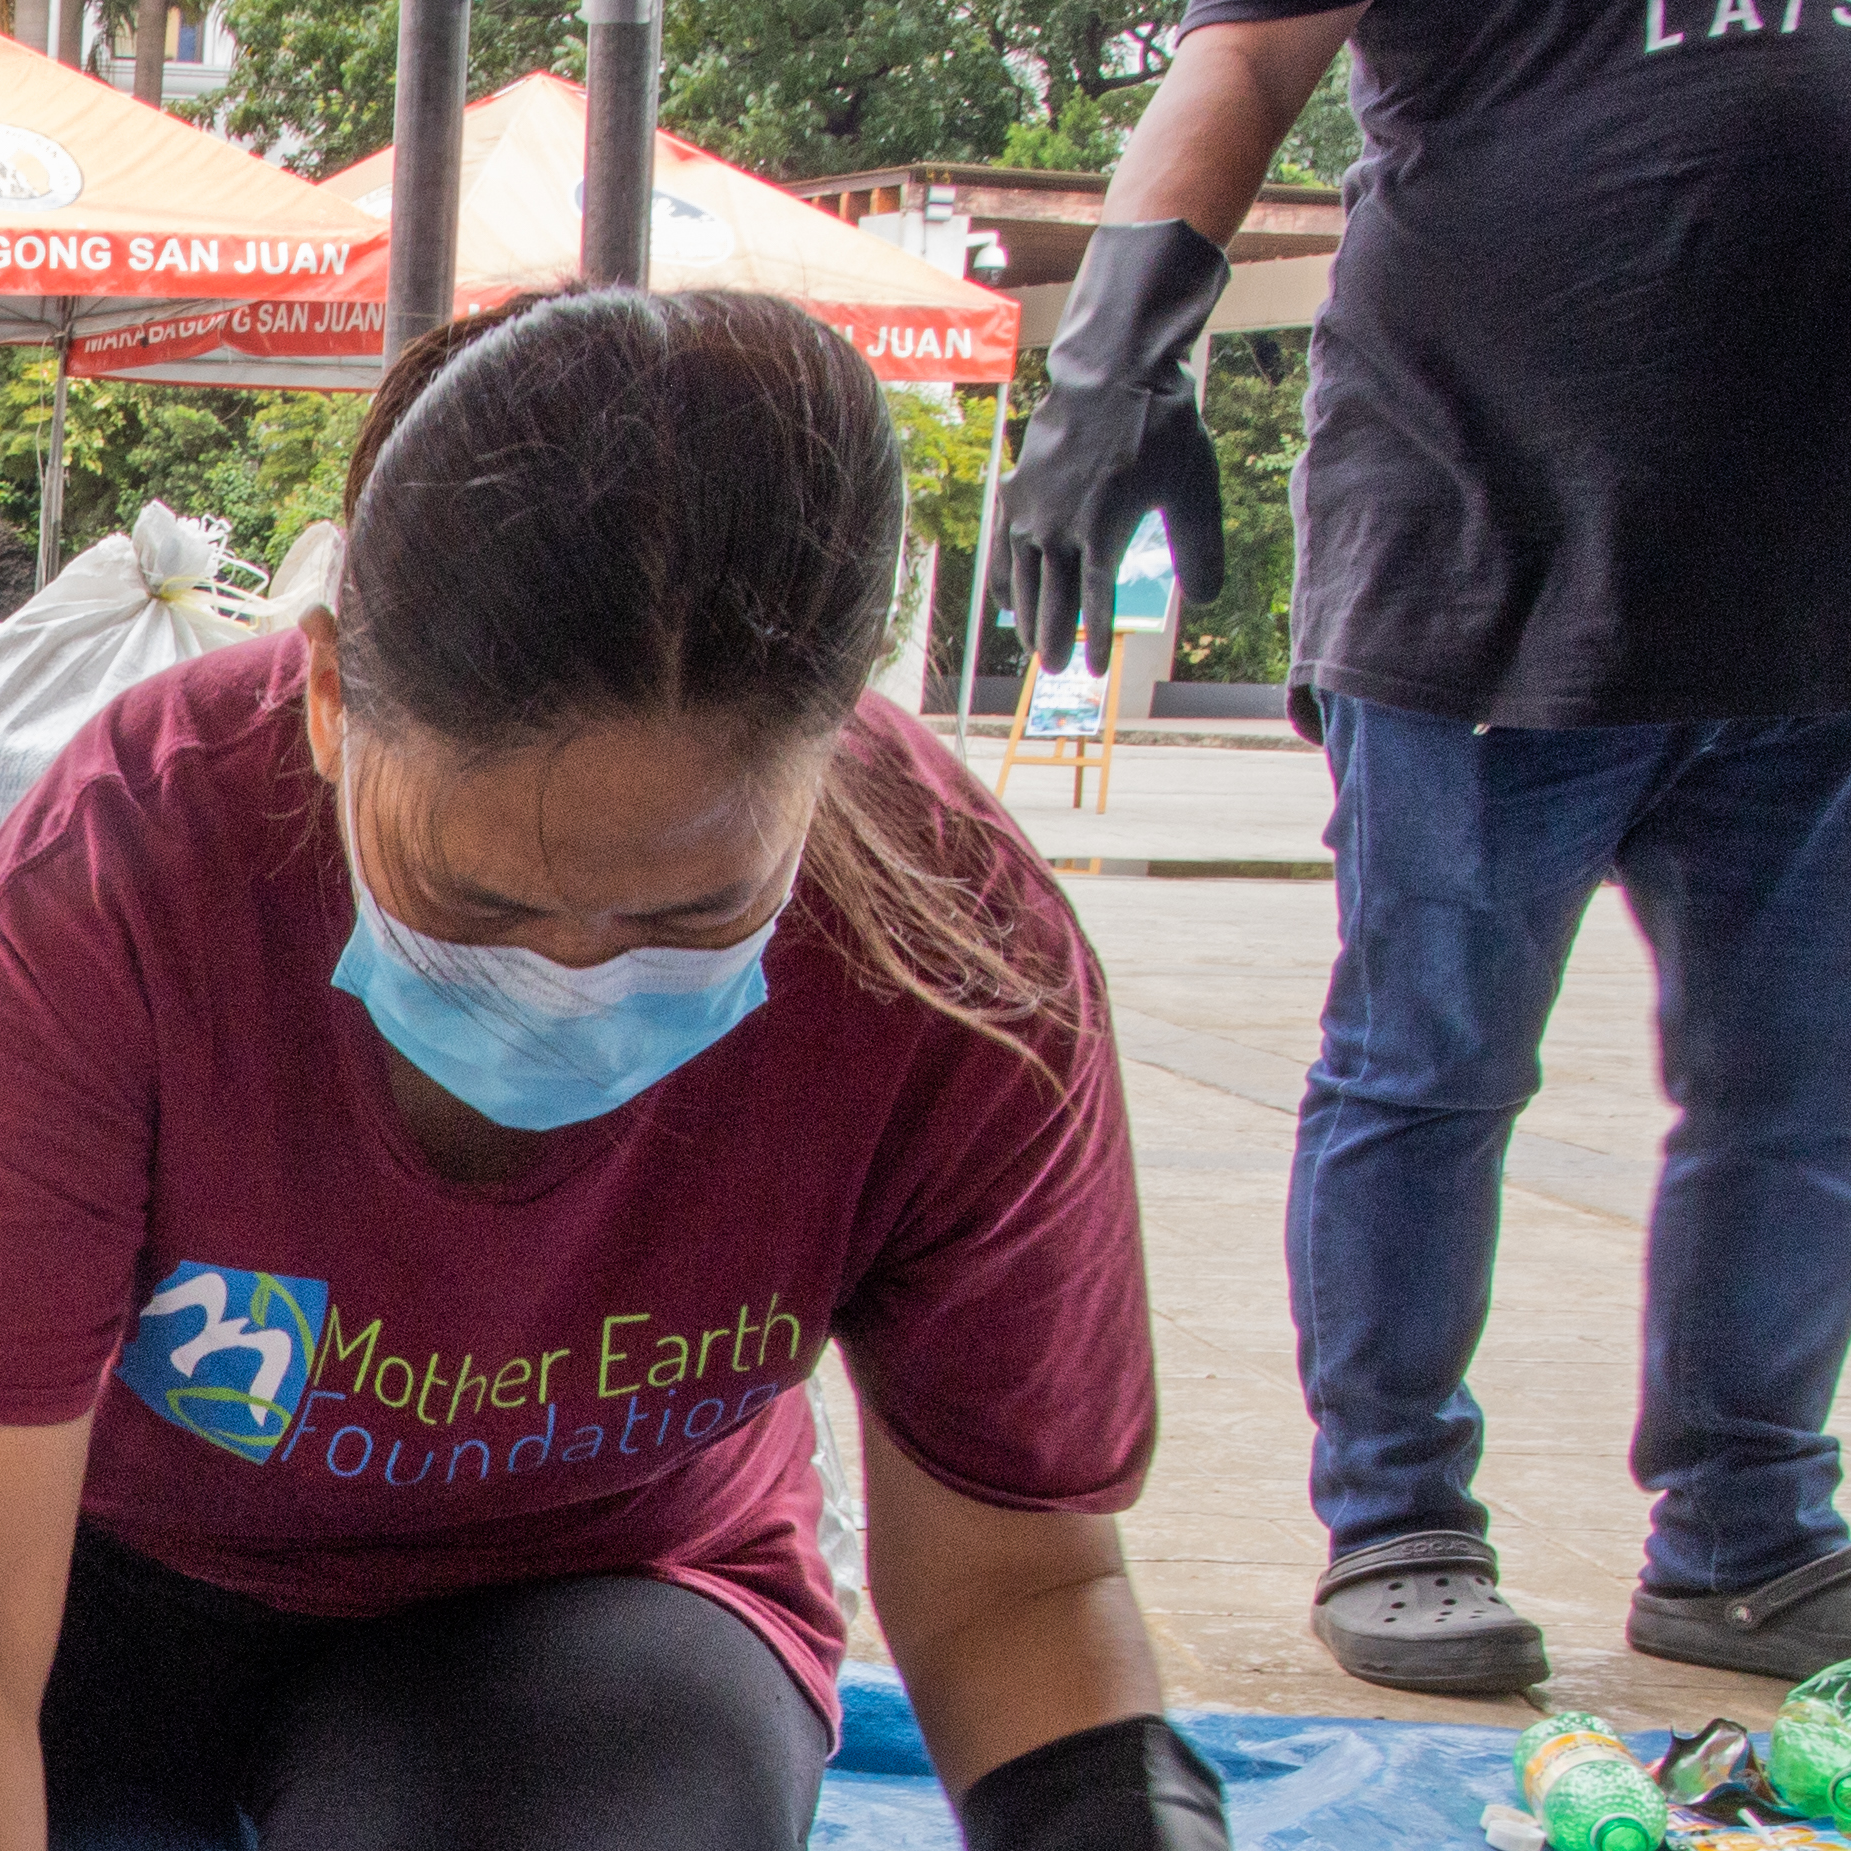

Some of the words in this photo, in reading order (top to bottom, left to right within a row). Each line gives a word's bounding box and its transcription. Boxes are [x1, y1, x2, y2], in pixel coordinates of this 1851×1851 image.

[127, 239, 220, 272] SAN
[233, 240, 351, 276] JUAN
[256, 302, 309, 334] SAN
[314, 302, 384, 334] JUAN
[867, 326, 973, 360] JUAN
[313, 1304, 571, 1425] Mother
[598, 1292, 801, 1399] Earth
[281, 1380, 778, 1487] Foundation
